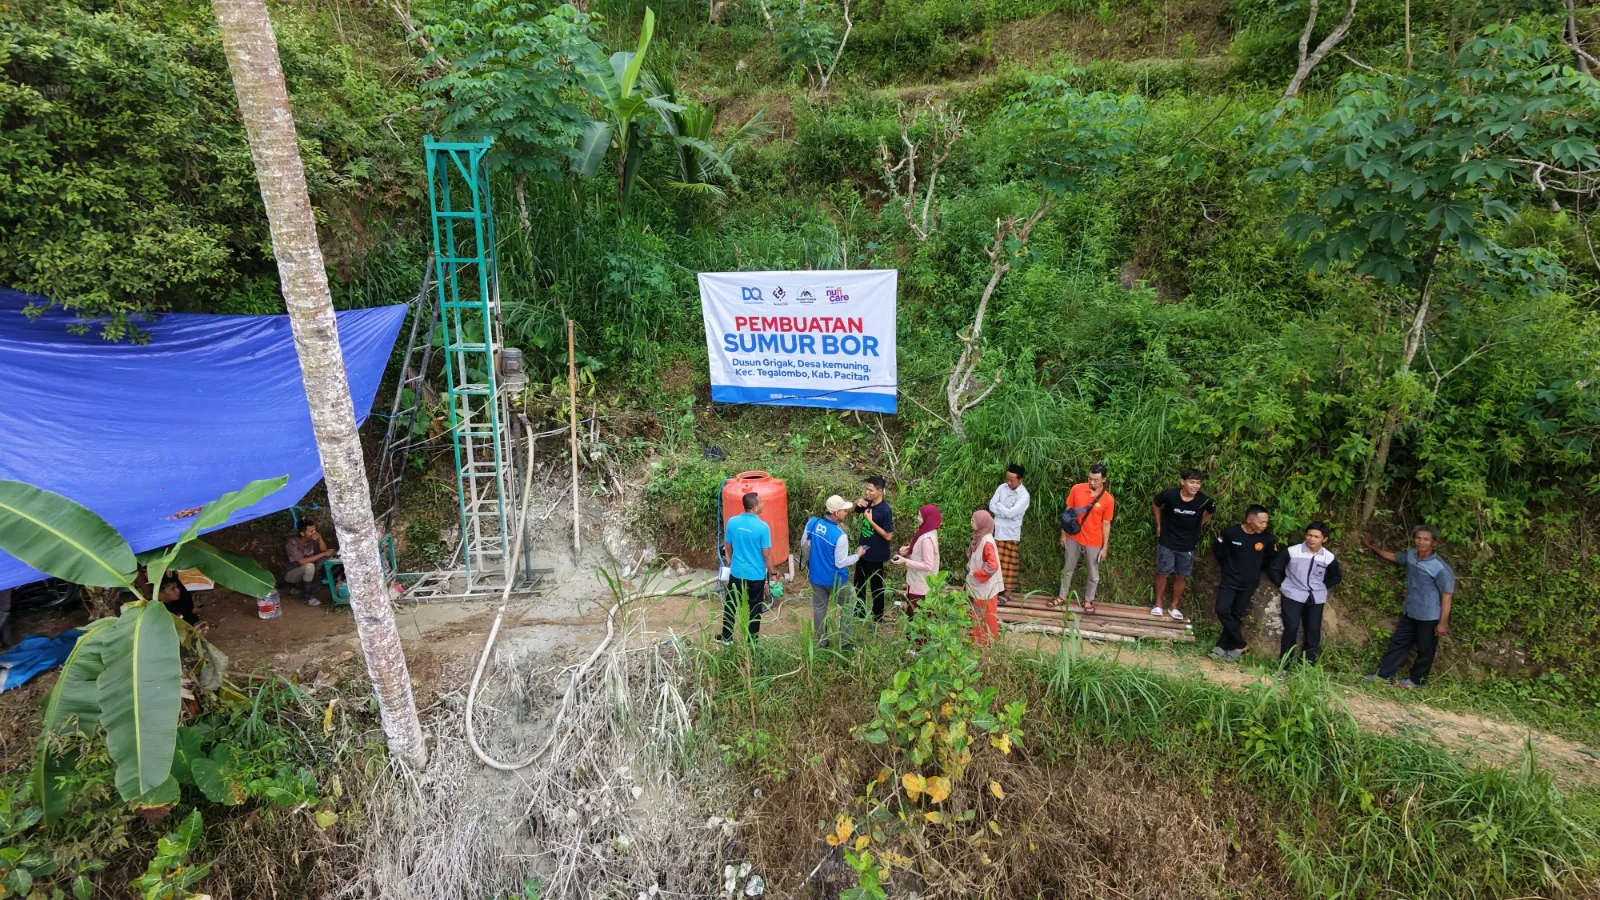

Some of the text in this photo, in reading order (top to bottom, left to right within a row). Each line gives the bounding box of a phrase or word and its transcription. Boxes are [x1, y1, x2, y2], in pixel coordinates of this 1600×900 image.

[829, 294, 849, 302] care
[735, 316, 863, 333] PEMBUATAN
[724, 333, 879, 356] SUMUR BOR
[732, 358, 871, 372] Dusun Grigak, Desa kemuning,
[735, 368, 869, 381] Kec. Tegalombo, Kab. Pacitan
